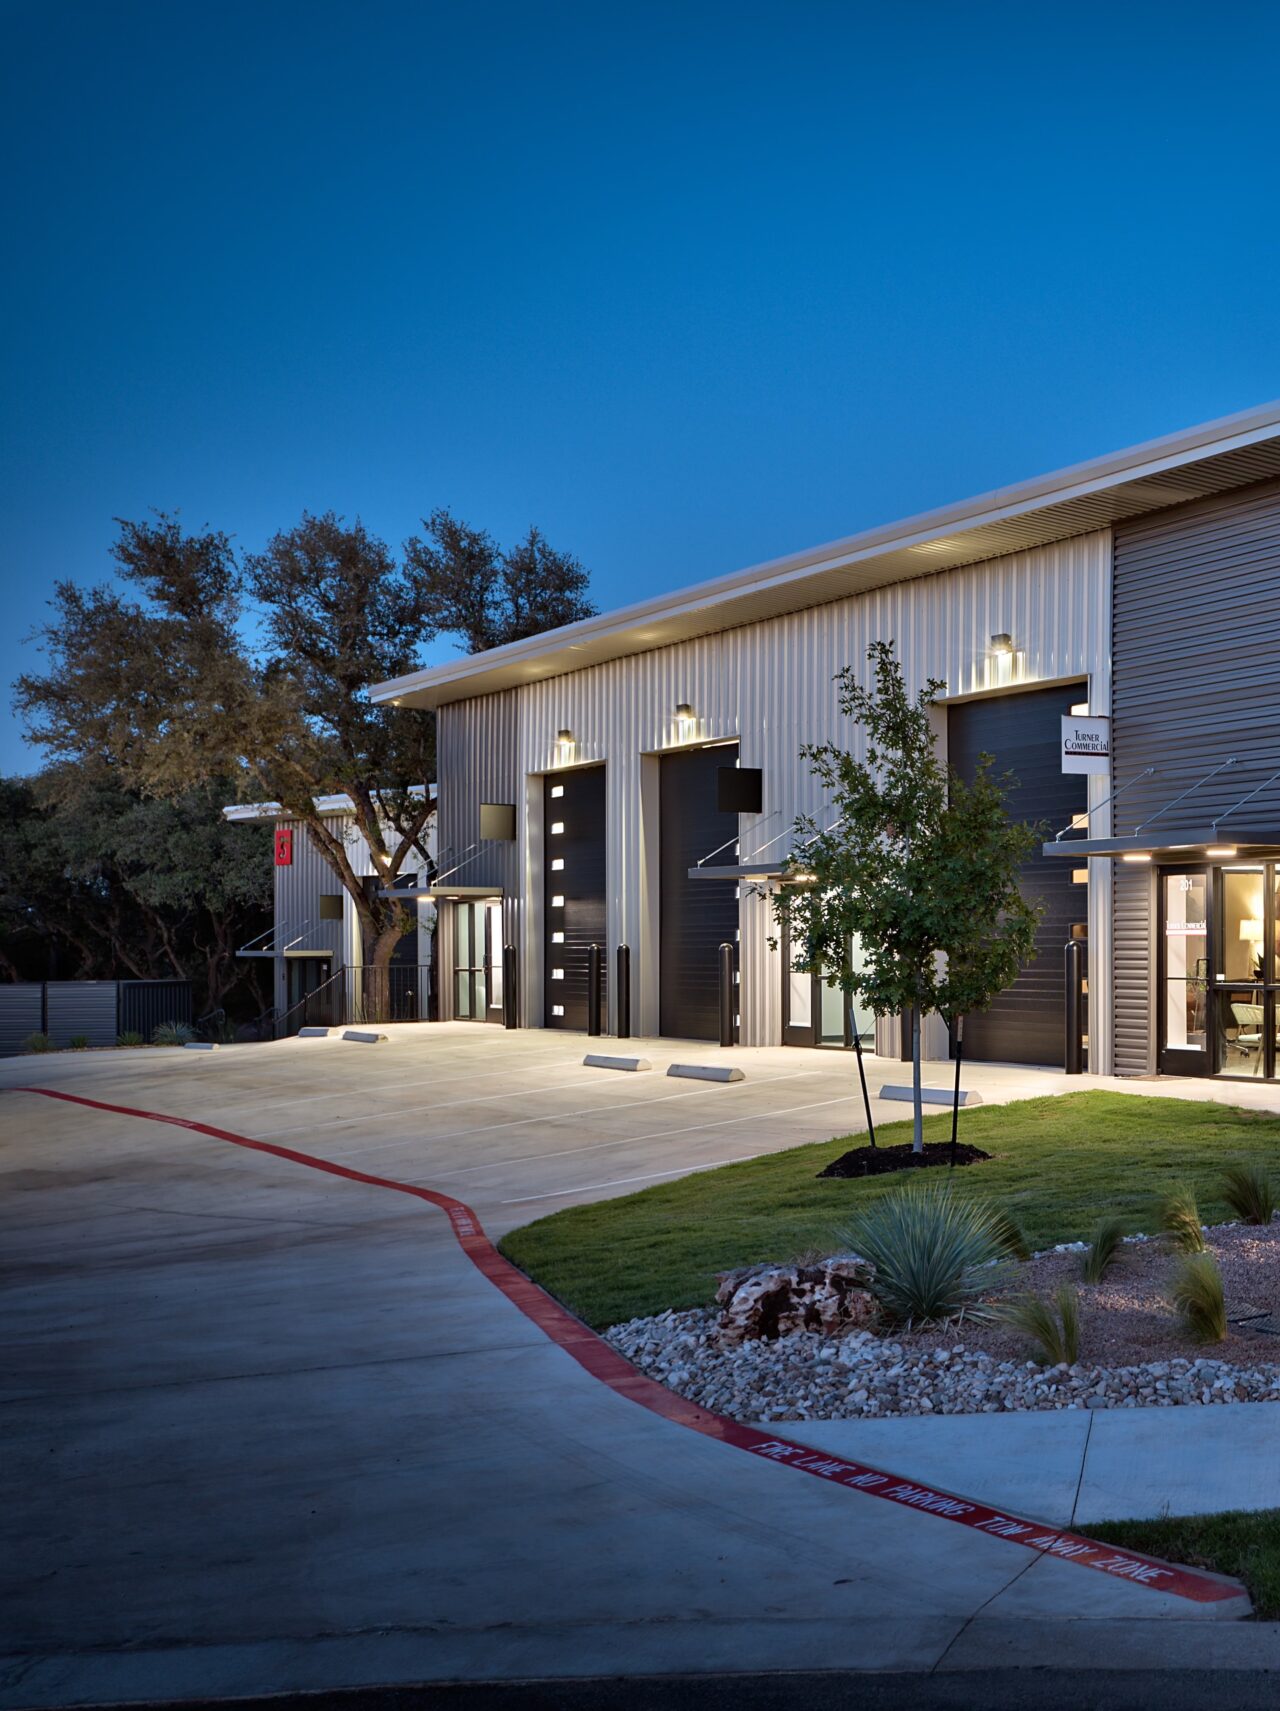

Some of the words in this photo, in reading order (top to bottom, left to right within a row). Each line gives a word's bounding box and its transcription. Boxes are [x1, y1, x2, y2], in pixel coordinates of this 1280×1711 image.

[1074, 730, 1099, 742] TURNER
[1179, 879, 1193, 891] 201
[747, 1441, 806, 1460] FIRE
[791, 1455, 857, 1477] LANE
[843, 1472, 889, 1488] NO
[880, 1484, 976, 1516] PARKING
[973, 1516, 1034, 1536] TOW
[1023, 1535, 1099, 1557] AWAY
[1089, 1555, 1174, 1583] ZONE
